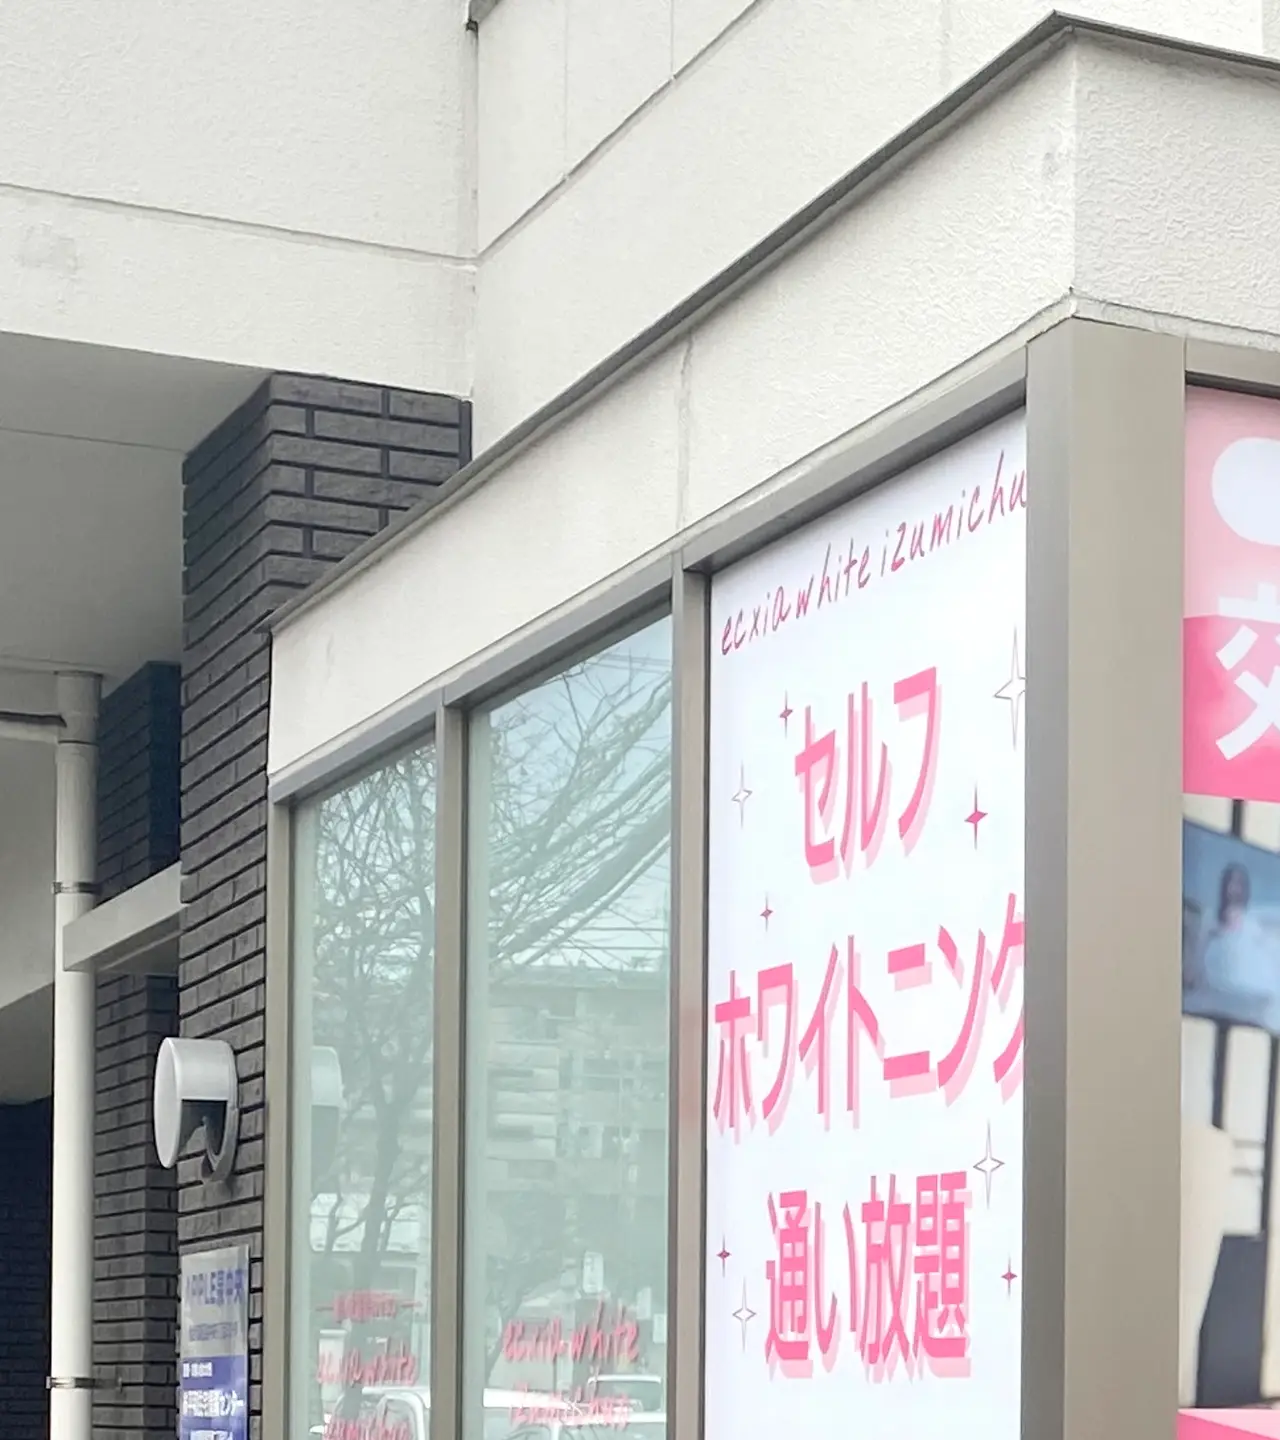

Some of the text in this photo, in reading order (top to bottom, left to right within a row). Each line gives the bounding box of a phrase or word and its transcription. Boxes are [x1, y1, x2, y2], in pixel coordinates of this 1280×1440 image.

[796, 537, 871, 619] white
[795, 667, 938, 870] セルフ
[766, 1170, 969, 1366] 通い放題
